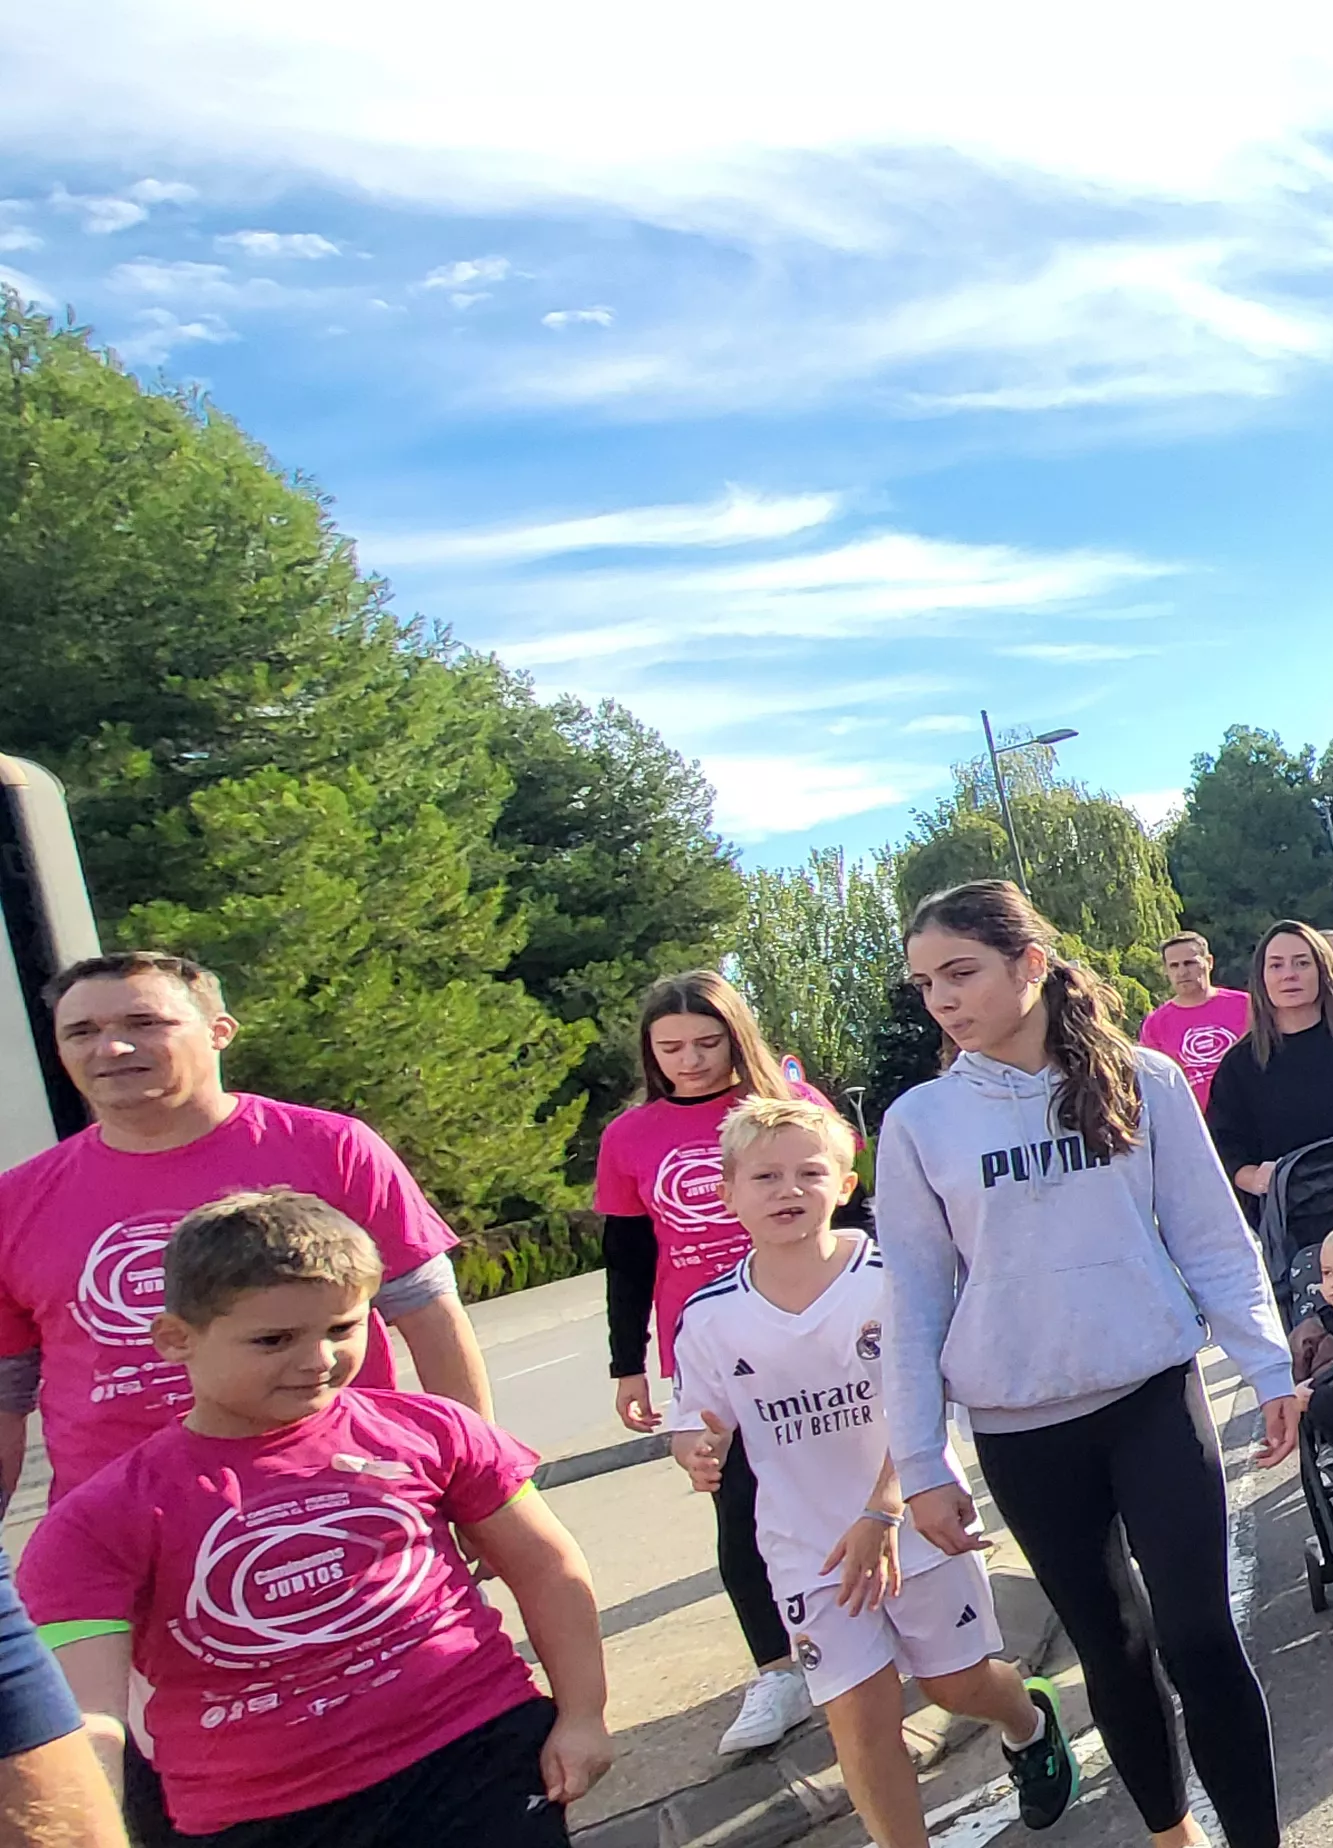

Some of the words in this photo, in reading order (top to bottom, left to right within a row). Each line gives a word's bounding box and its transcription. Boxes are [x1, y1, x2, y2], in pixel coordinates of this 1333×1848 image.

[754, 1379, 878, 1422] Emirate
[775, 1419, 803, 1446] FLY
[811, 1405, 873, 1436] BETTER
[265, 1562, 344, 1601] JUNTOS
